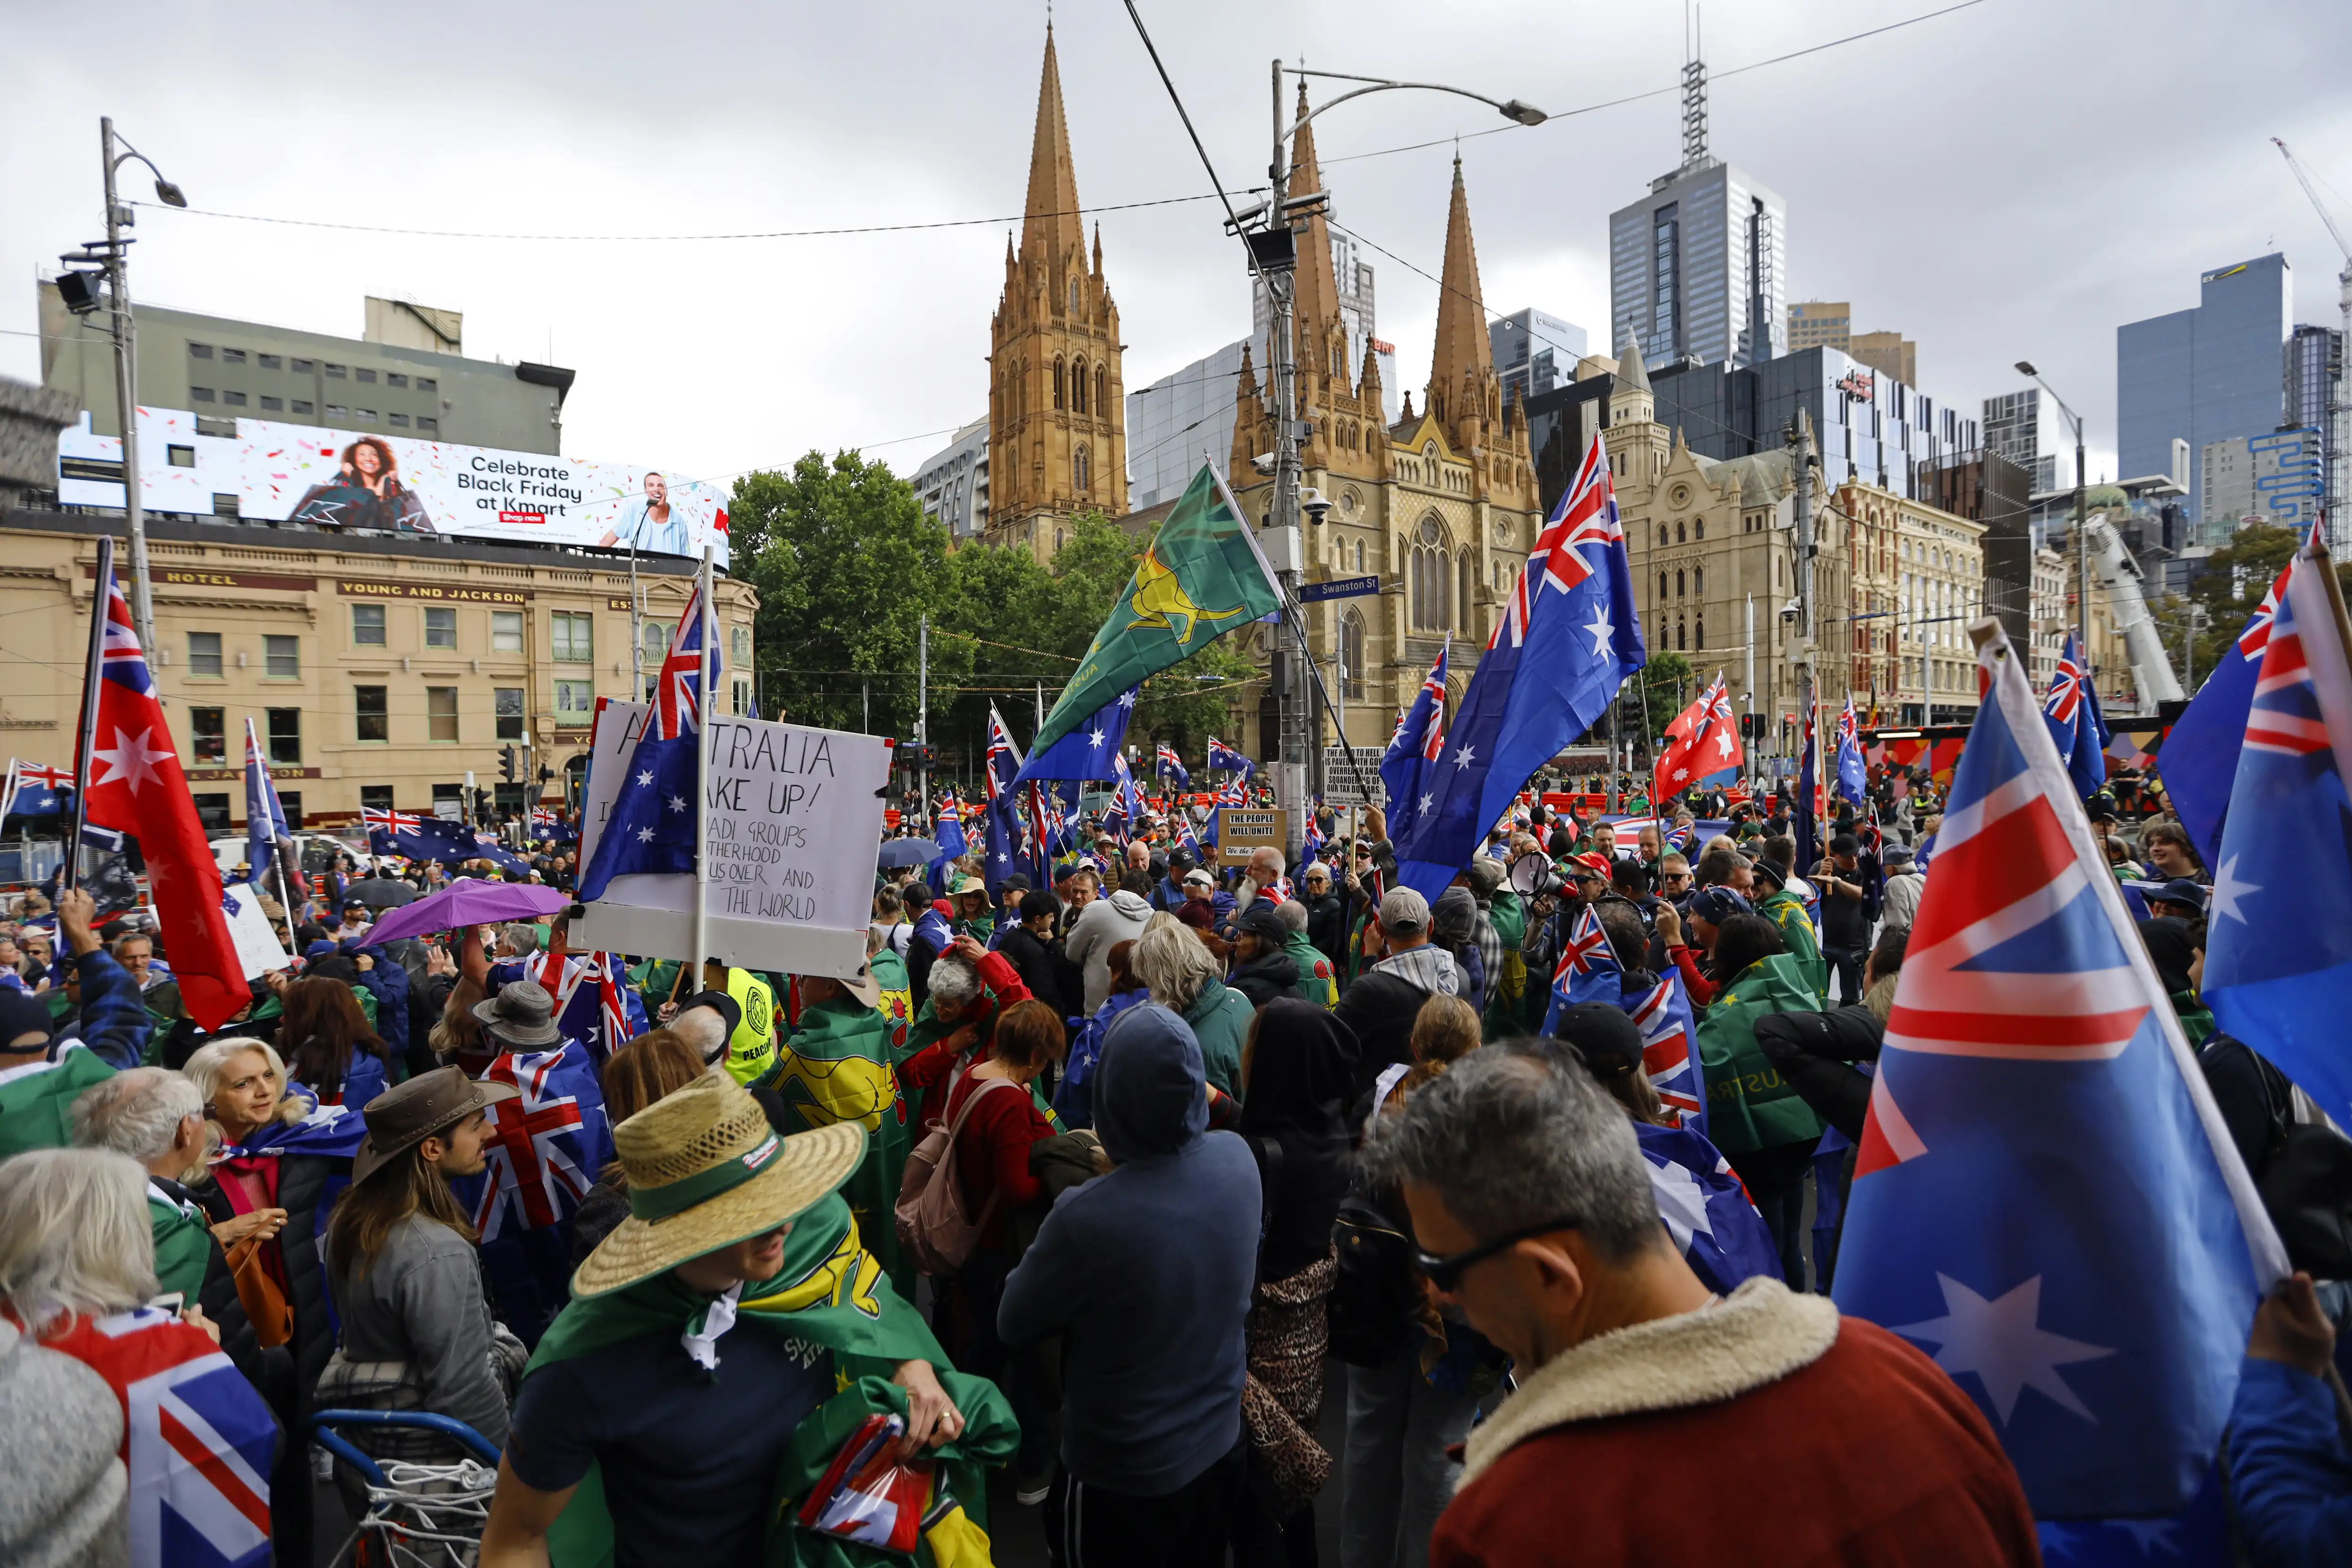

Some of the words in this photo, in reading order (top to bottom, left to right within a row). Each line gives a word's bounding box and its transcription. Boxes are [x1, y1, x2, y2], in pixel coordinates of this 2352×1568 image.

[1374, 338, 1395, 354] BHP
[471, 456, 569, 480] Celebrate
[458, 473, 513, 493] Black
[520, 479, 581, 503] Friday
[477, 497, 497, 509] at
[504, 497, 565, 516] Kmart
[503, 513, 523, 522] Shop
[167, 572, 238, 585] HOTEL
[1322, 581, 1364, 594] Swanston
[1367, 578, 1376, 588] St
[343, 583, 402, 595] YOUNG
[409, 587, 442, 597] AND
[448, 590, 524, 603] JACKSON
[617, 711, 834, 778] ATRALIA
[207, 769, 305, 780] JASON
[1328, 776, 1372, 785] SQUANDERG
[1329, 767, 1363, 775] OVERREAH
[707, 775, 751, 812] KE
[768, 782, 821, 815] UP!
[1351, 785, 1382, 794] DOARS.
[598, 802, 609, 822] I
[748, 822, 807, 848] GROUPS
[707, 841, 781, 864] THERHOOD
[709, 861, 725, 879] US
[729, 864, 768, 885] OVER
[721, 886, 753, 914] THE
[758, 891, 815, 921] WORLD
